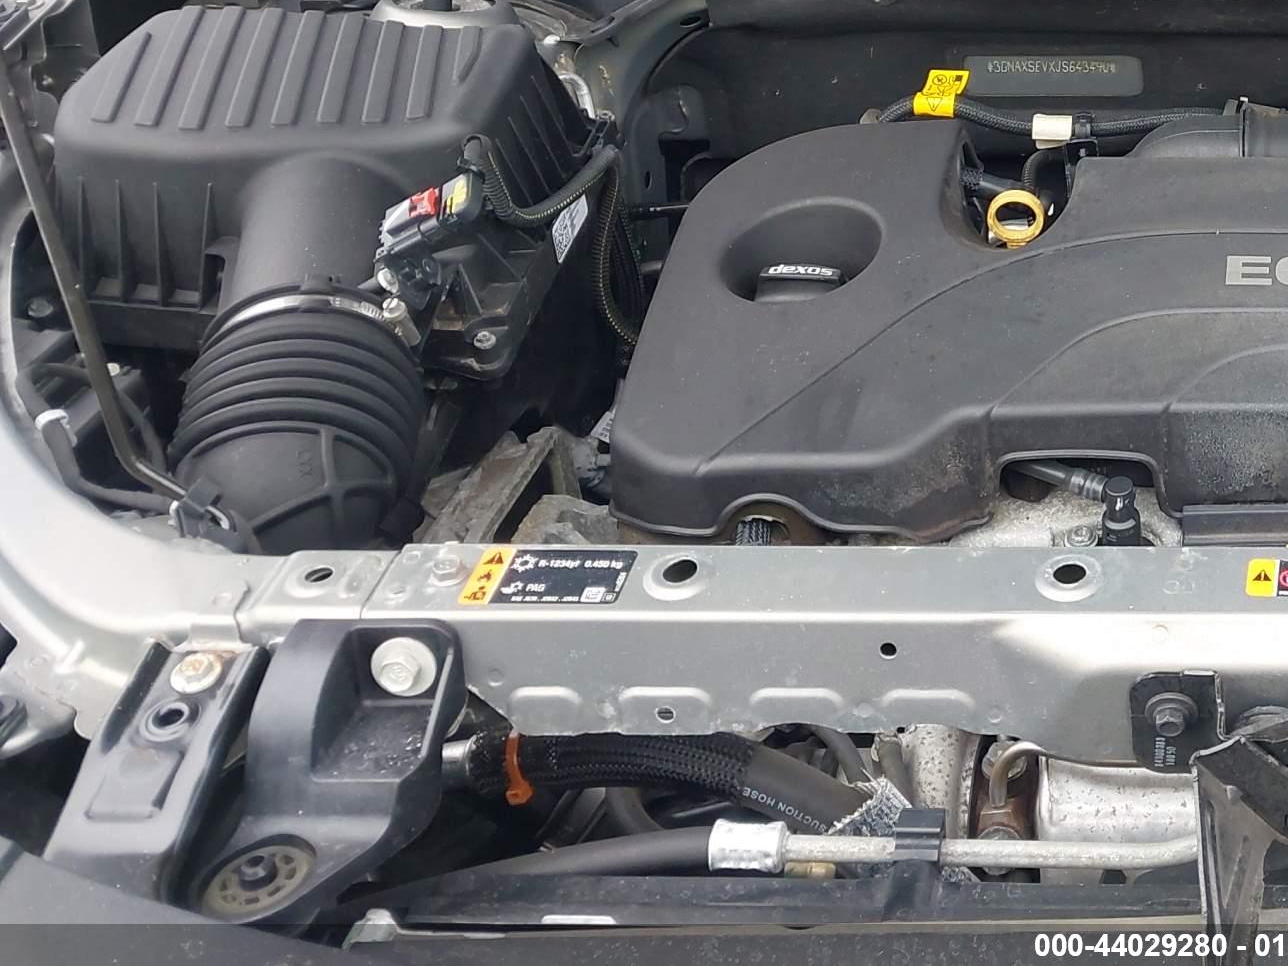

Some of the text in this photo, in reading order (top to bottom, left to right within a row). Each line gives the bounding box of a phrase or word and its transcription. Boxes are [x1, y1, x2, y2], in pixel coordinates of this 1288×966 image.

[768, 264, 833, 276] dexos
[610, 561, 623, 570] kg
[742, 786, 830, 835] SUCTION HOSE
